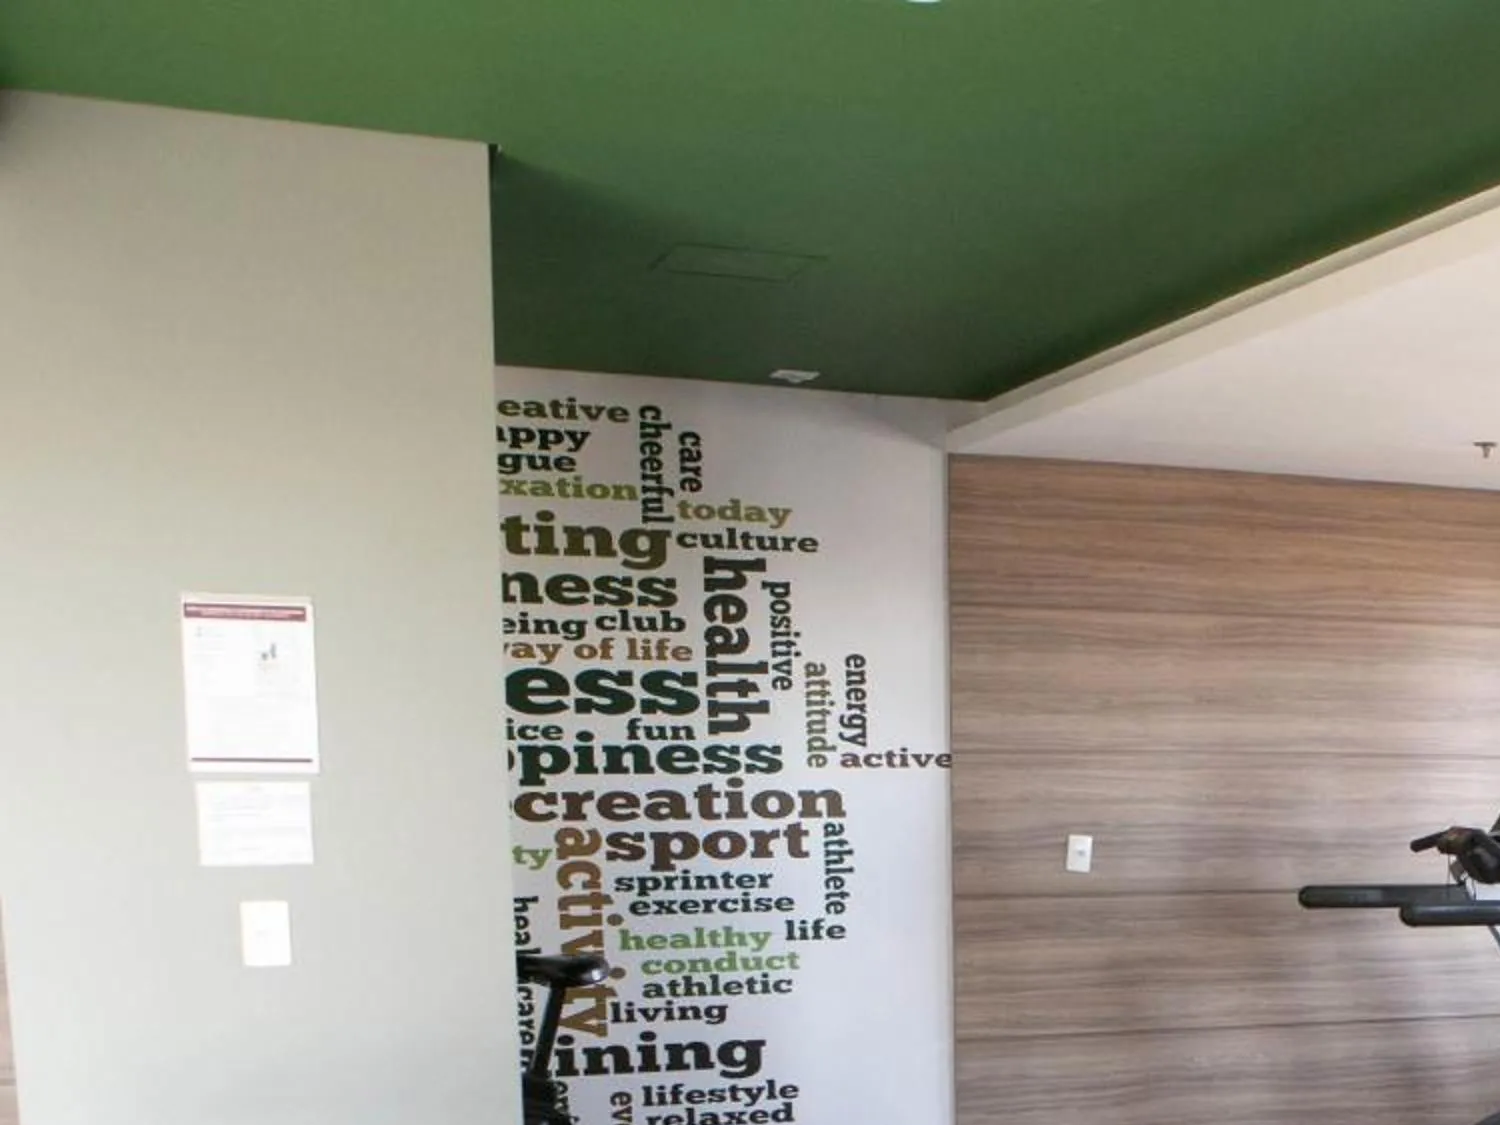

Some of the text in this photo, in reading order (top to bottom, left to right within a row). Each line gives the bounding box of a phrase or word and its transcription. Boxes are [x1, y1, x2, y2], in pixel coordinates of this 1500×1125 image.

[497, 397, 630, 423] eative
[497, 452, 577, 475] gue
[639, 405, 675, 524] cheerful
[678, 431, 703, 492] care
[499, 475, 638, 501] xation
[677, 499, 792, 529] today
[501, 510, 671, 570] ting
[677, 528, 818, 553] culture
[502, 571, 678, 607] ness
[596, 609, 686, 632] club
[703, 556, 770, 735] health
[762, 581, 802, 691] positive
[504, 638, 693, 664] ay of life
[505, 667, 700, 715] ess
[839, 653, 866, 747] energy
[804, 662, 837, 768] attitude
[506, 718, 564, 740] ice
[627, 718, 695, 740] fun
[508, 731, 783, 786] piness
[840, 747, 952, 768] active
[512, 845, 552, 870] ty
[606, 822, 809, 872] sport
[823, 821, 853, 915] athlete
[614, 870, 773, 896] sprinter
[629, 891, 794, 916] exercise
[555, 827, 626, 1037] activty
[619, 926, 772, 952] healthy
[785, 919, 846, 941] life
[641, 950, 800, 975] conduct
[642, 973, 793, 999] athletic
[611, 1000, 728, 1024] living
[554, 1031, 766, 1078] ining
[642, 1080, 799, 1106] lifestyle
